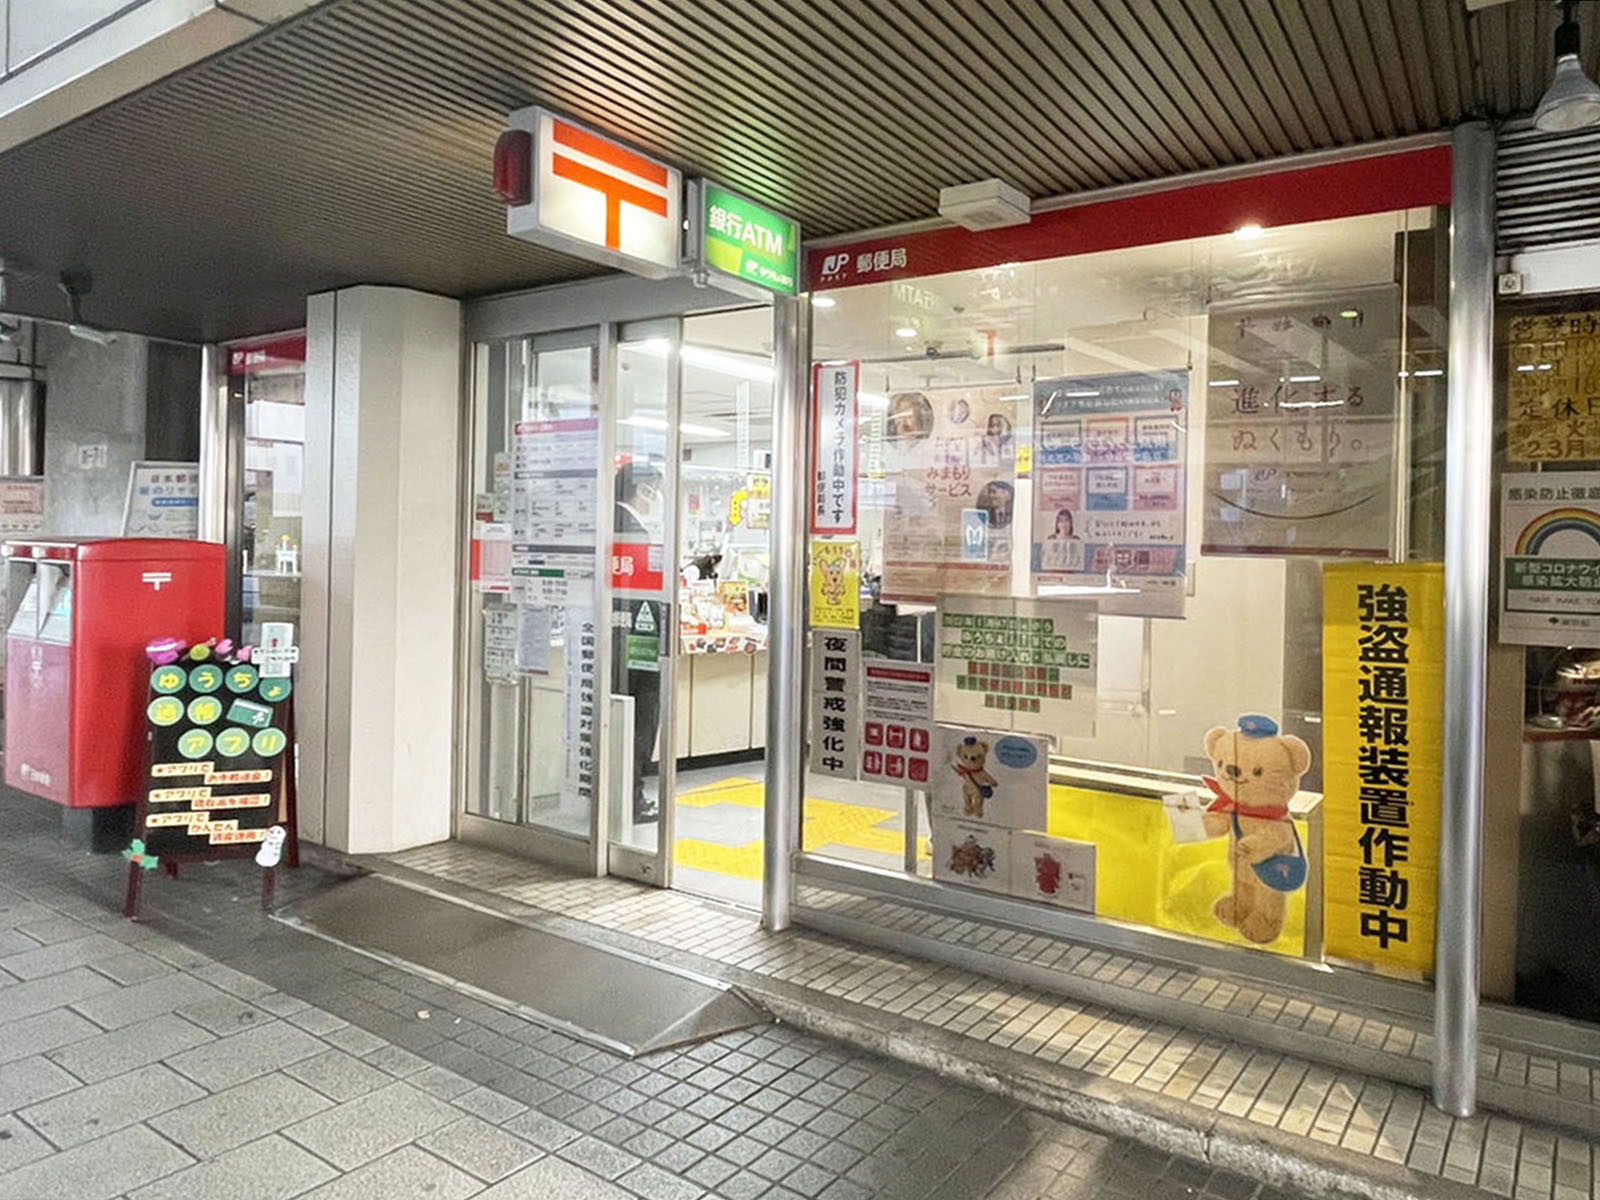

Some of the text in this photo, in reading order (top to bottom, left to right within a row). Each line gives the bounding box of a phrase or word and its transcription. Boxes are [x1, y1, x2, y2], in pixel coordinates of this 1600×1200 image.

[709, 205, 783, 256] 銀行ATM
[857, 248, 907, 273] 郵便局
[1232, 386, 1364, 414] 進化する
[832, 371, 848, 524] 防犯カメラ作動中です
[1233, 423, 1368, 457] ぬくもり。
[926, 466, 971, 481] みまもり
[925, 484, 972, 498] サービス
[822, 637, 848, 771] 夜間警戒強化中
[1357, 584, 1410, 949] 強盗通報装置作動中
